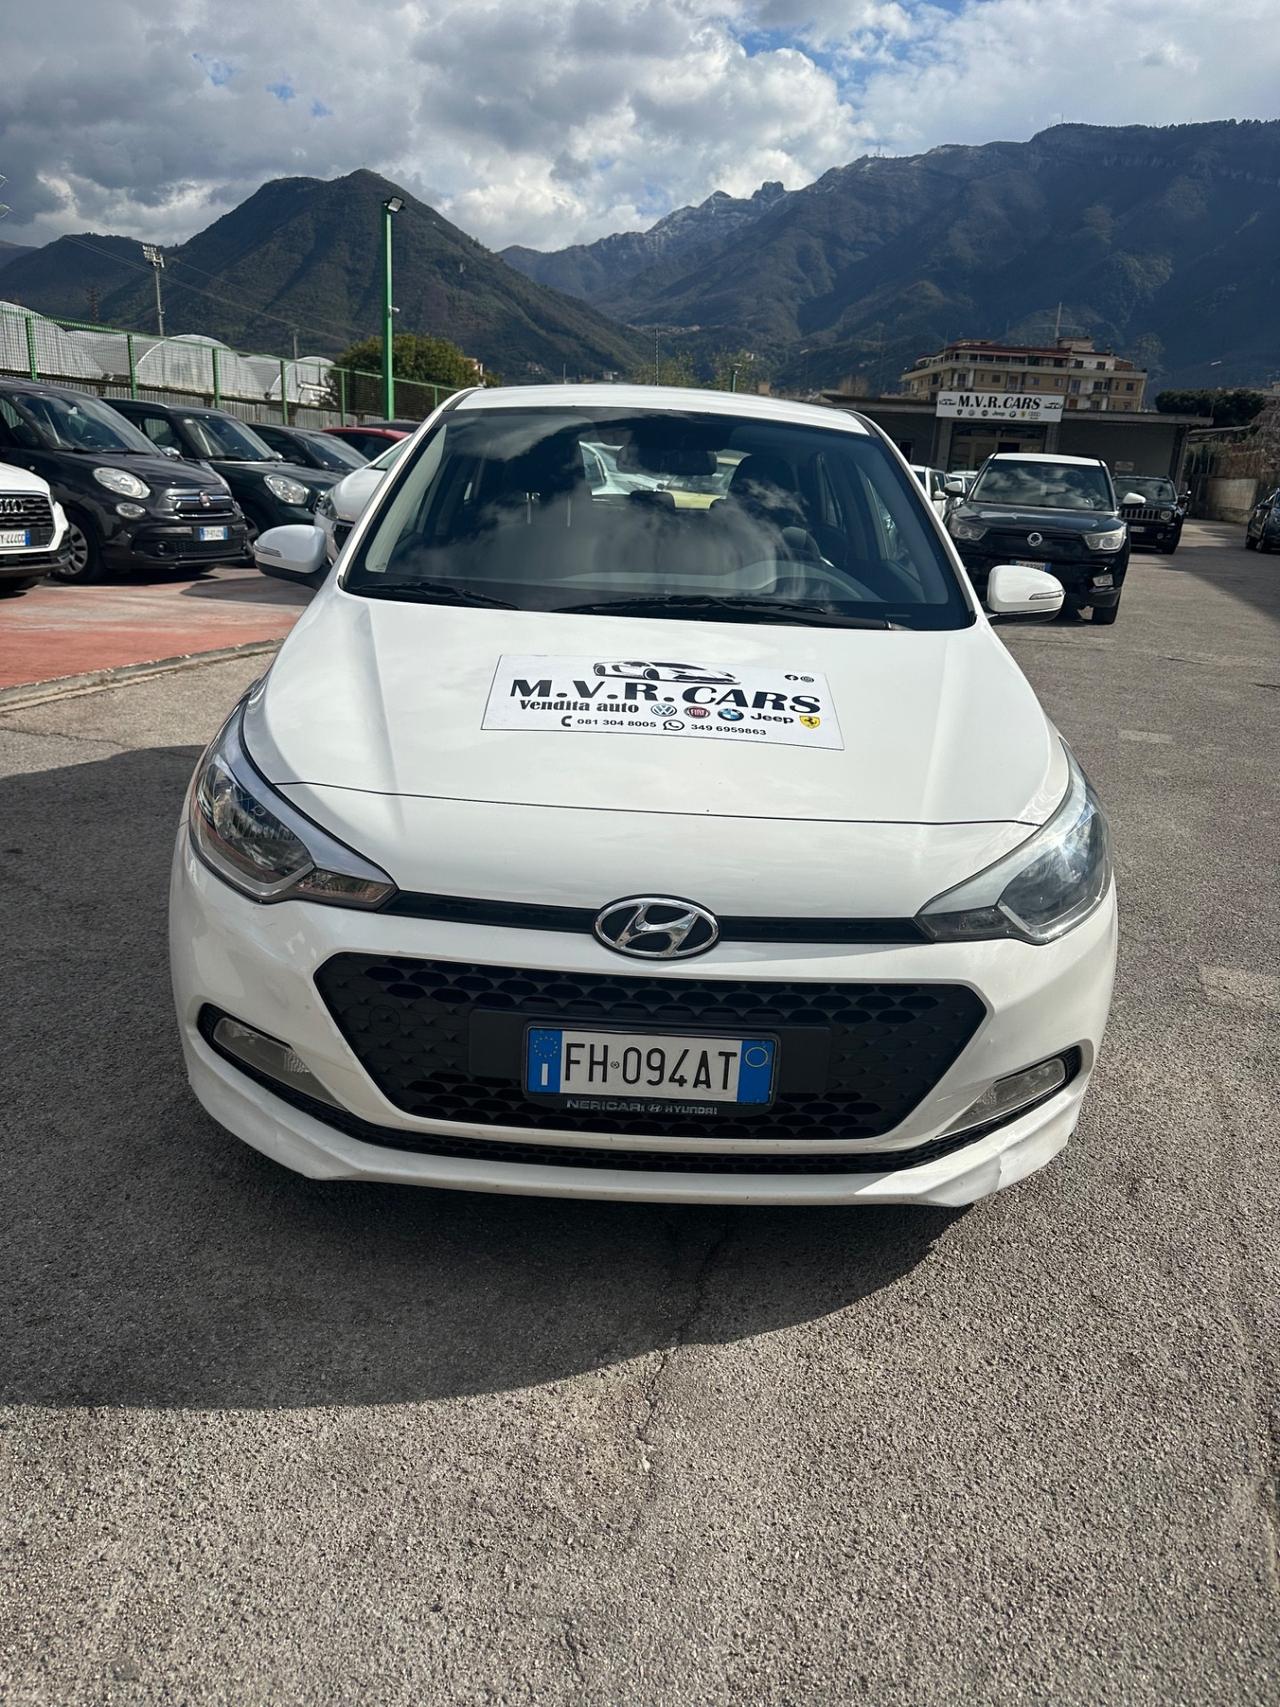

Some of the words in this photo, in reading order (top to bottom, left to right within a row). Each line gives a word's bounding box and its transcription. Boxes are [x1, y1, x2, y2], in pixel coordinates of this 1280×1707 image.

[520, 700, 590, 712] Vendita
[596, 701, 640, 713] auto
[750, 713, 794, 724] Jeep
[627, 720, 657, 728] 8005
[690, 723, 713, 731] 349
[715, 725, 767, 736] 6959863
[665, 1105, 718, 1116] HYUNDAI
